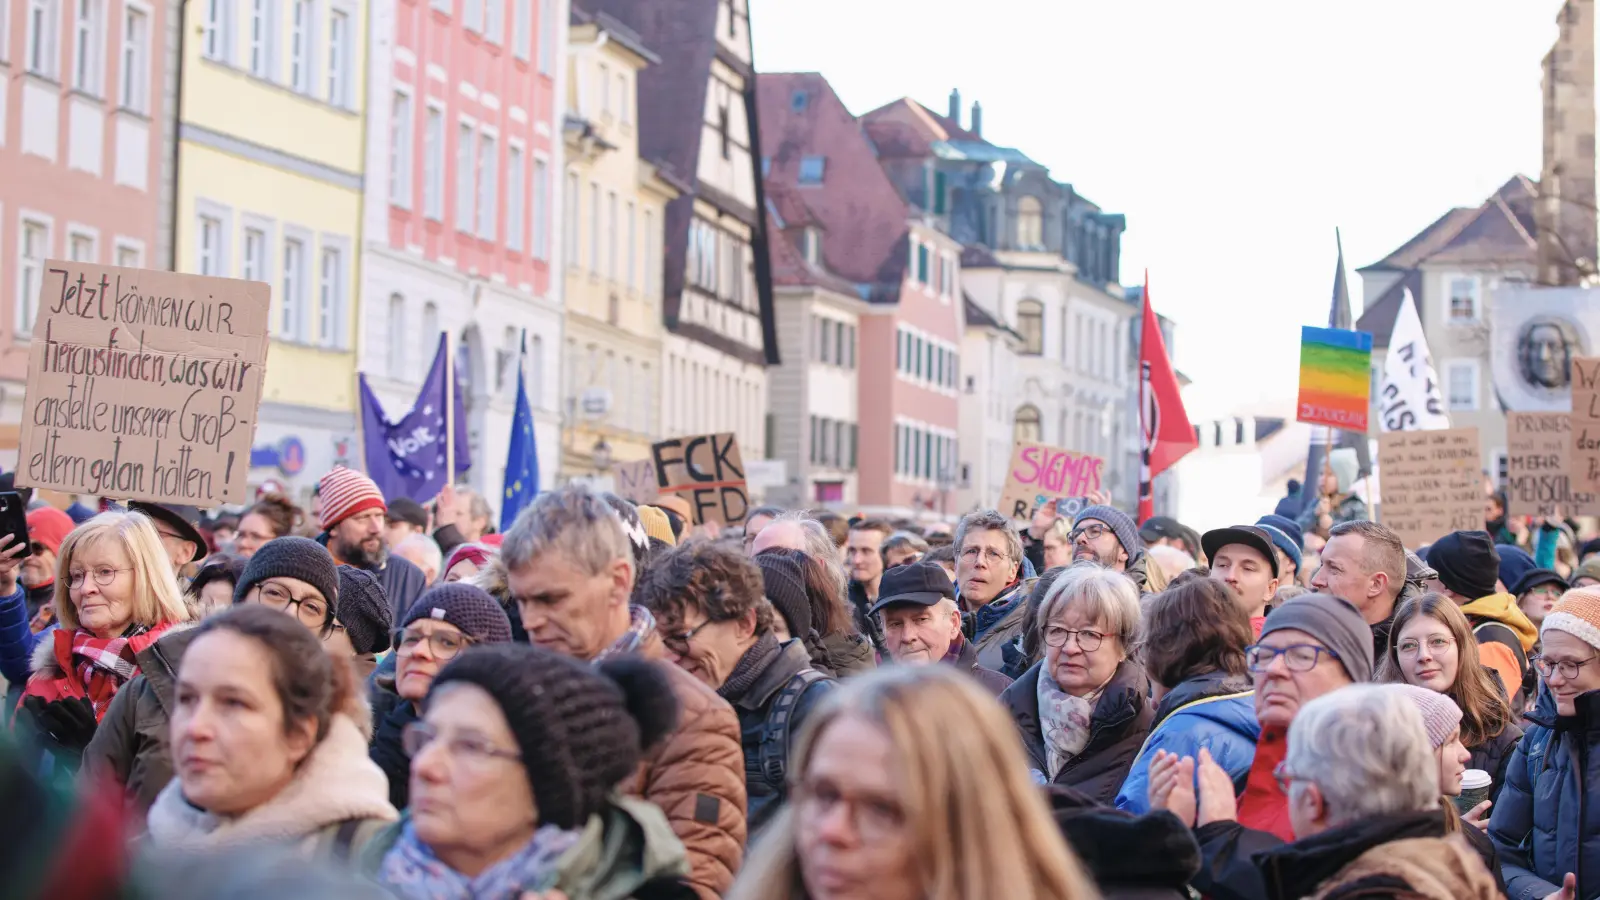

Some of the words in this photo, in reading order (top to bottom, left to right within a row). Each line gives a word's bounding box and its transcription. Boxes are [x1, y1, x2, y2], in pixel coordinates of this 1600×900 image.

[49, 268, 109, 320] Jetzt
[43, 318, 167, 387] herausfinden,
[169, 353, 208, 389] was
[210, 352, 252, 392] wir
[34, 375, 108, 432] anstelle
[112, 404, 176, 440] unserer
[29, 430, 86, 487] eltern
[88, 436, 144, 494] getan
[388, 426, 435, 458] Volt
[652, 434, 745, 487] FCK
[1510, 455, 1561, 470] MEHR
[1013, 447, 1104, 496] SIGMAS
